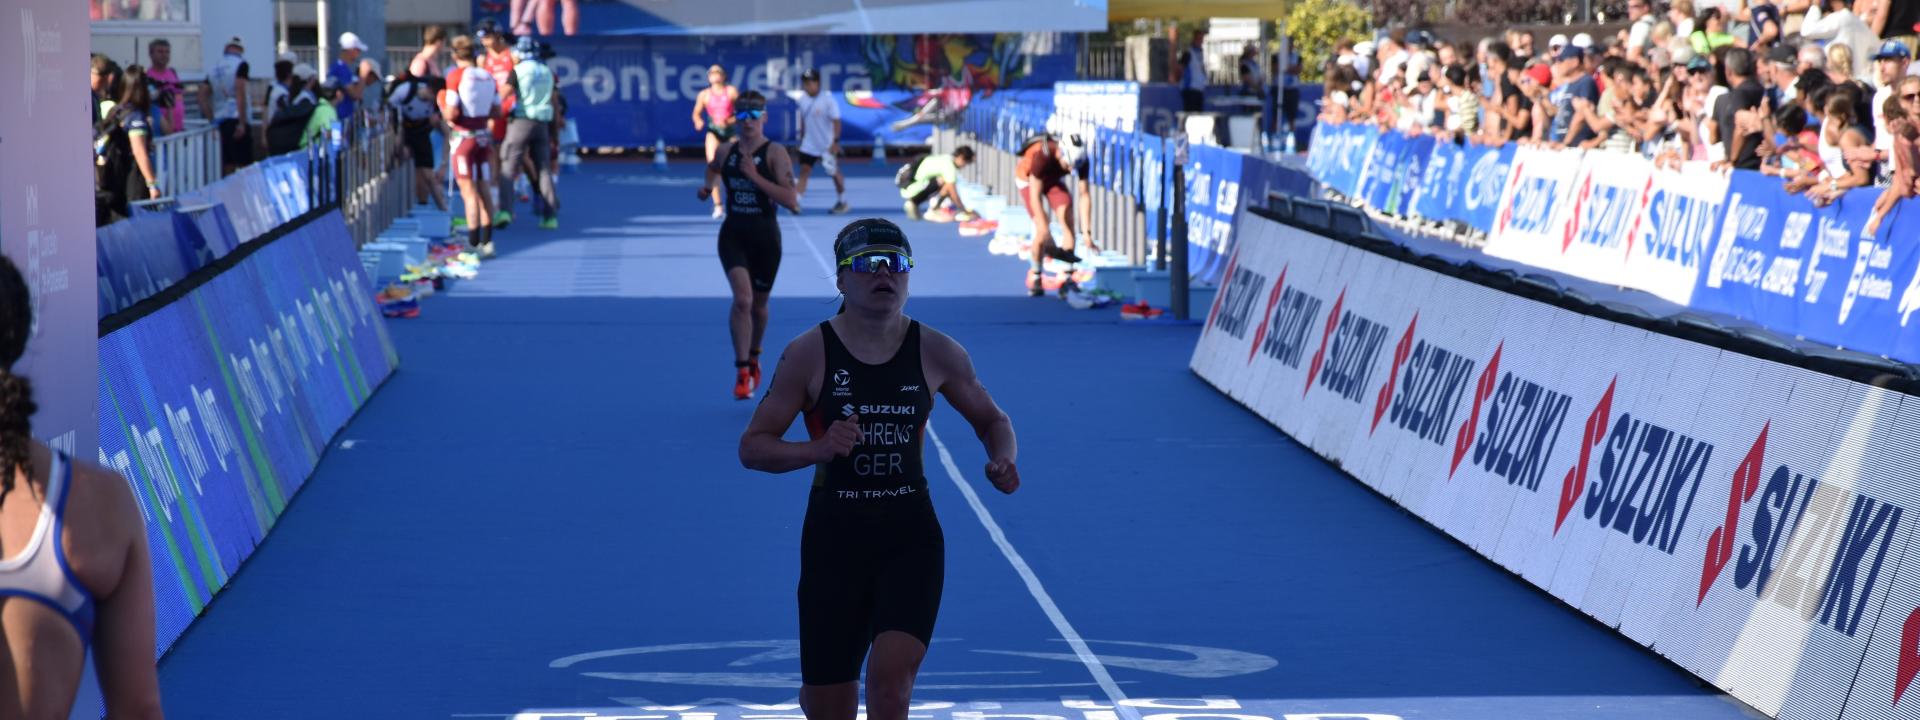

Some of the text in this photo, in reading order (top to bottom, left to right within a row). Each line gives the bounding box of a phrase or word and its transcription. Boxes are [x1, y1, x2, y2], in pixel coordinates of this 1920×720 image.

[549, 52, 872, 104] Pontevedra
[735, 191, 757, 204] GBR
[1263, 284, 1322, 370] SUZUKI
[1320, 309, 1389, 404] SUZUKI
[859, 405, 915, 415] SUZUKI
[1390, 338, 1475, 446] SUZUKI
[853, 452, 904, 476] GER
[855, 422, 914, 445] HRENS
[1472, 371, 1572, 493] SUZUKI
[836, 484, 916, 499] TRI TRAVEL
[1584, 412, 1714, 556] SUZUKI
[1733, 463, 1904, 638] SUZUKI
